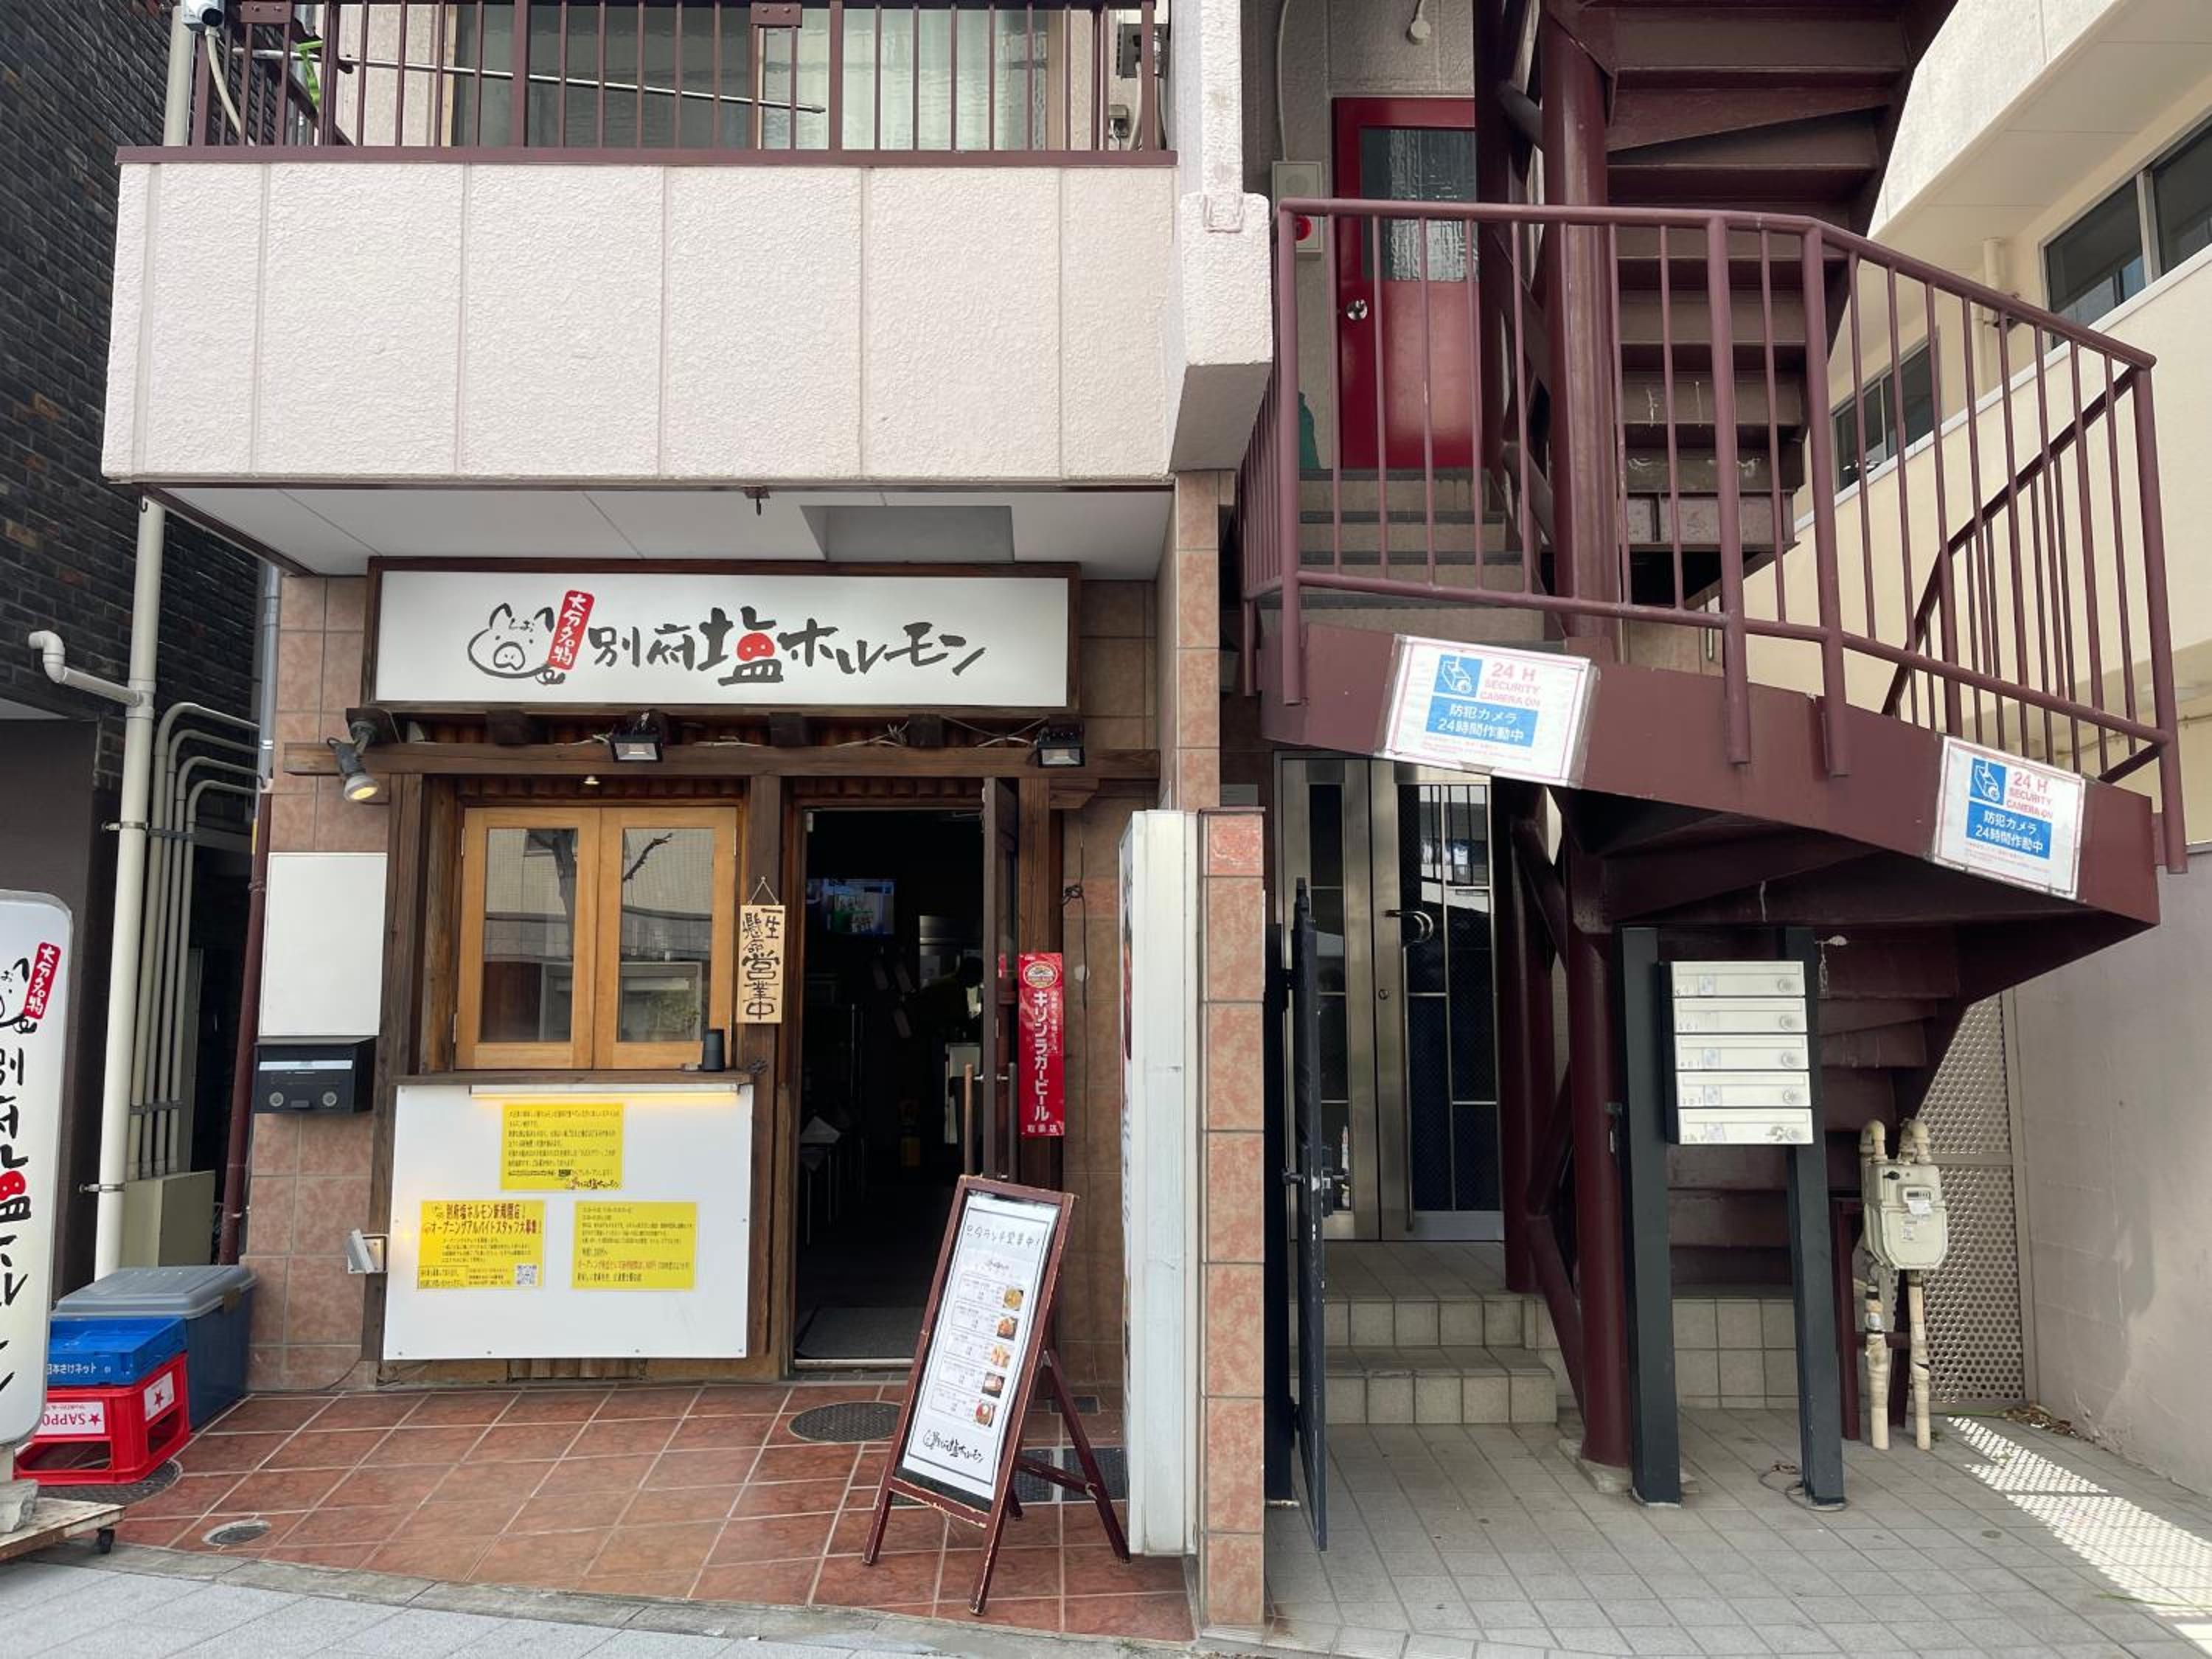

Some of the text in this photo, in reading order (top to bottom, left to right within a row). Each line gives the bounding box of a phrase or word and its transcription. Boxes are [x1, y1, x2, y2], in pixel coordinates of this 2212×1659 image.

[551, 594, 587, 665] 大分名物
[589, 606, 987, 686] 別府塩ホルモン
[1492, 662, 1536, 681] 24 H
[1485, 678, 1541, 693] SECURITY
[1481, 692, 1541, 708] CAMERA ON
[1450, 703, 1517, 726] 防犯カメラ
[1437, 717, 1525, 742] 24時間作動中
[2008, 787, 2053, 804] SECURITY
[2014, 772, 2048, 794] 24 H
[2006, 800, 2040, 817] CAMERA
[1984, 810, 2037, 835] 防犯カメラ
[1975, 824, 2044, 854] 24時間作動中
[761, 908, 783, 939] 一生
[27, 945, 56, 1016] 大分名物
[742, 950, 781, 1020] 営業中
[1034, 990, 1049, 1121] キリンラガービール
